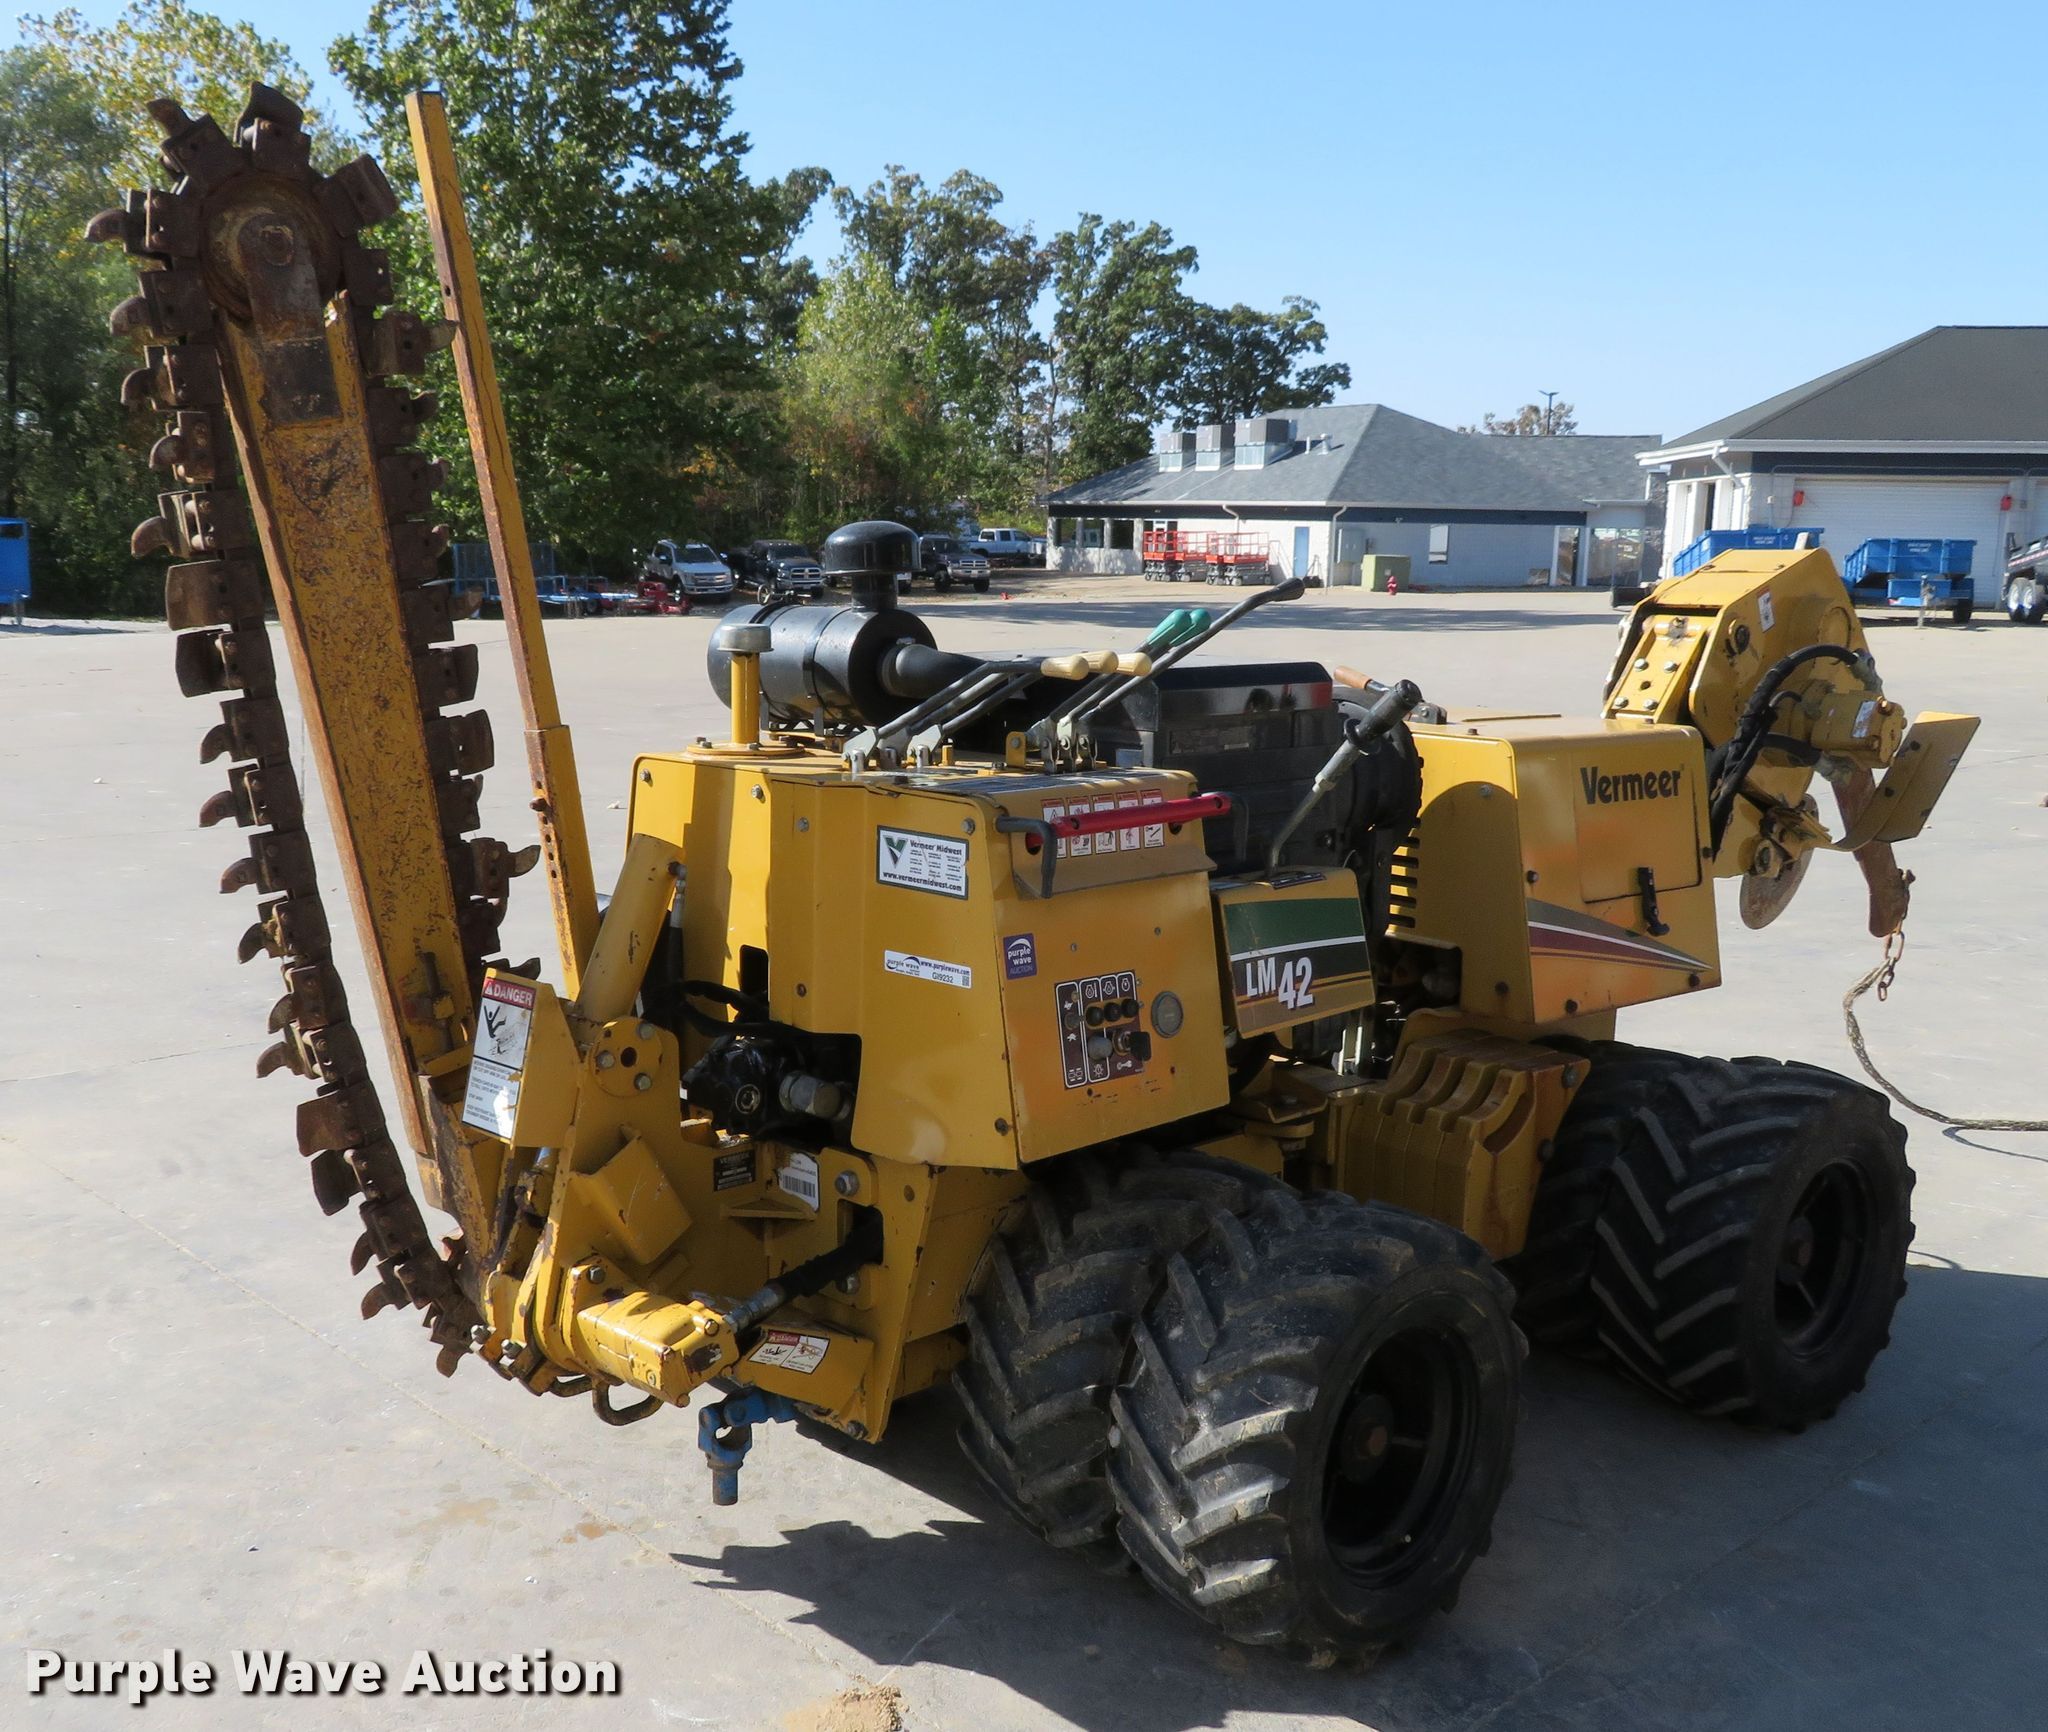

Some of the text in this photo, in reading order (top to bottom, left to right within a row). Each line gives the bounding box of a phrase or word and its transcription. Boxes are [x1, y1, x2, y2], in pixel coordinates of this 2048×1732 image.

[1579, 765, 1681, 805] Vermeer
[910, 840, 962, 856] Vermeer Midwest
[883, 872, 962, 892] www.vermeermidwest.com
[1007, 946, 1031, 960] purple
[1012, 956, 1032, 966] wave
[1246, 956, 1313, 1010] LM 42
[493, 983, 534, 1007] DANGER
